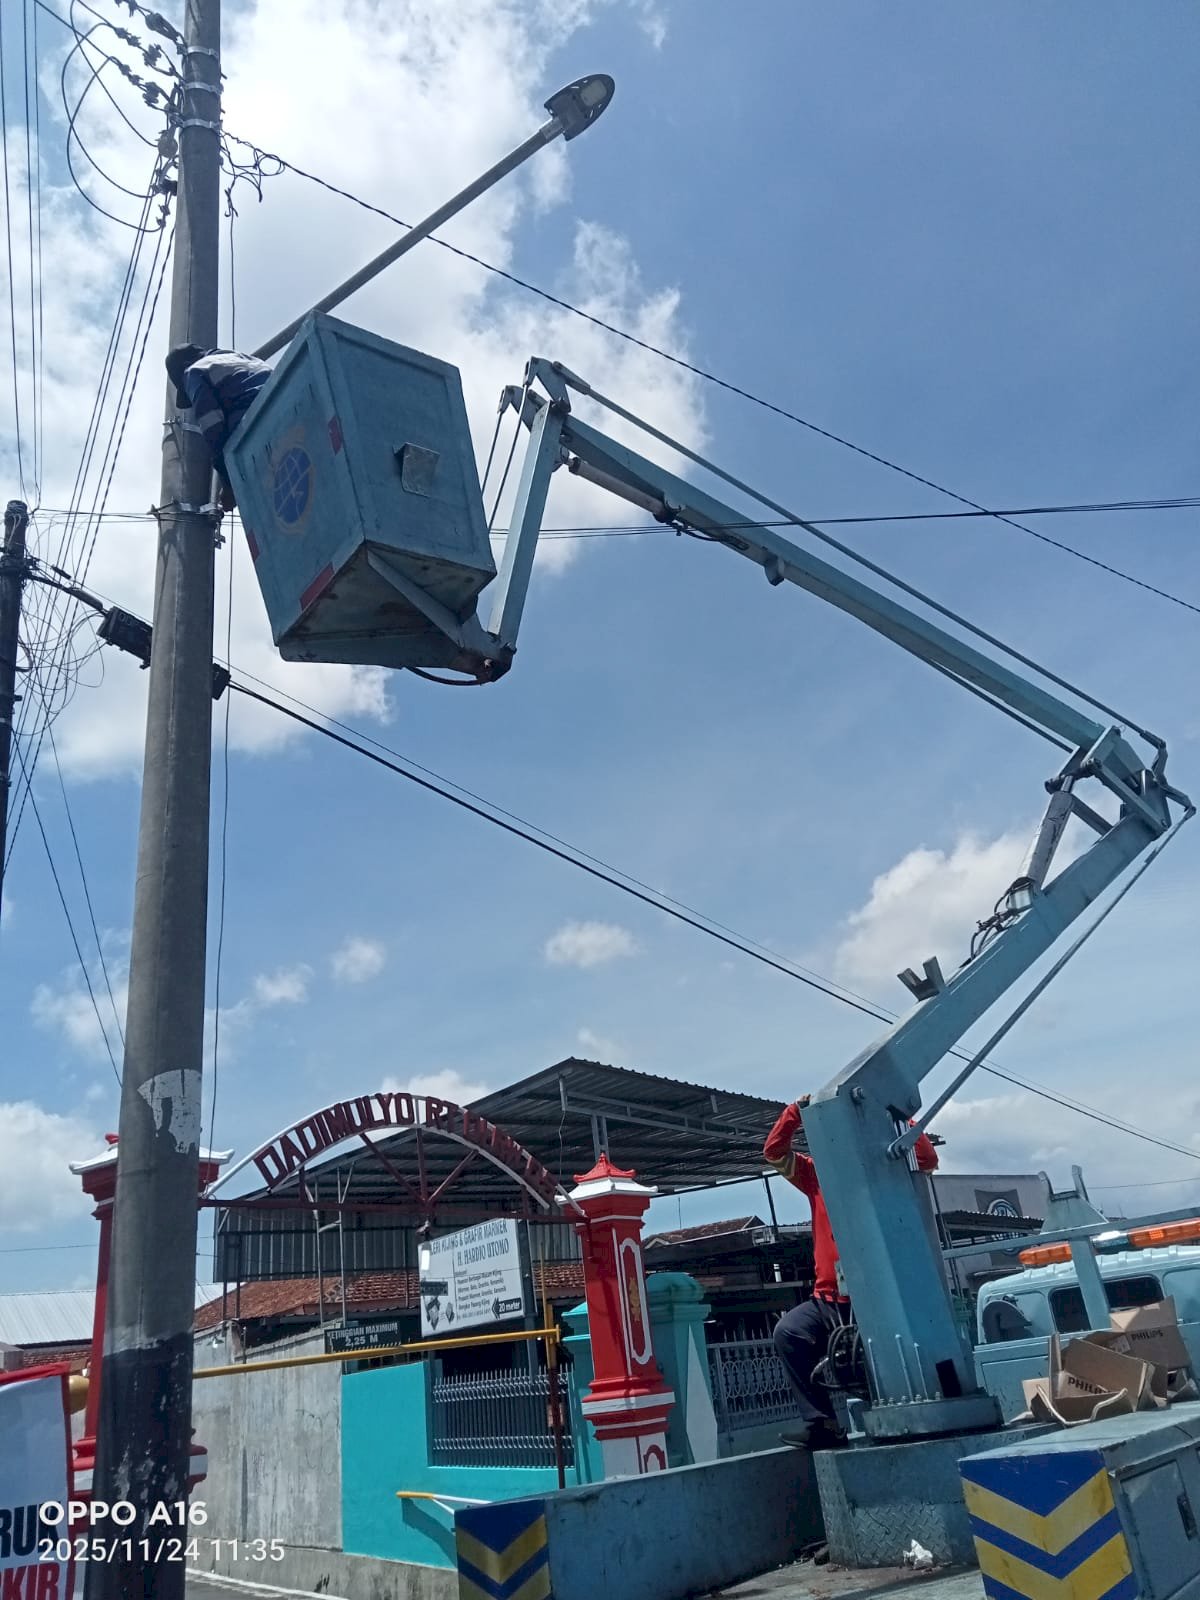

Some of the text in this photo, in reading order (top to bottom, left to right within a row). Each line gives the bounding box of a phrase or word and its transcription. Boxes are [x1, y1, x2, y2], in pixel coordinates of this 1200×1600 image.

[254, 1092, 415, 1190] DADIMULYO
[425, 1095, 460, 1131] RT
[487, 1238, 509, 1257] UTOMO
[499, 1303, 505, 1313] 20
[505, 1301, 520, 1311] meter
[365, 1322, 398, 1334] MAXIMUM
[369, 1334, 378, 1343] M
